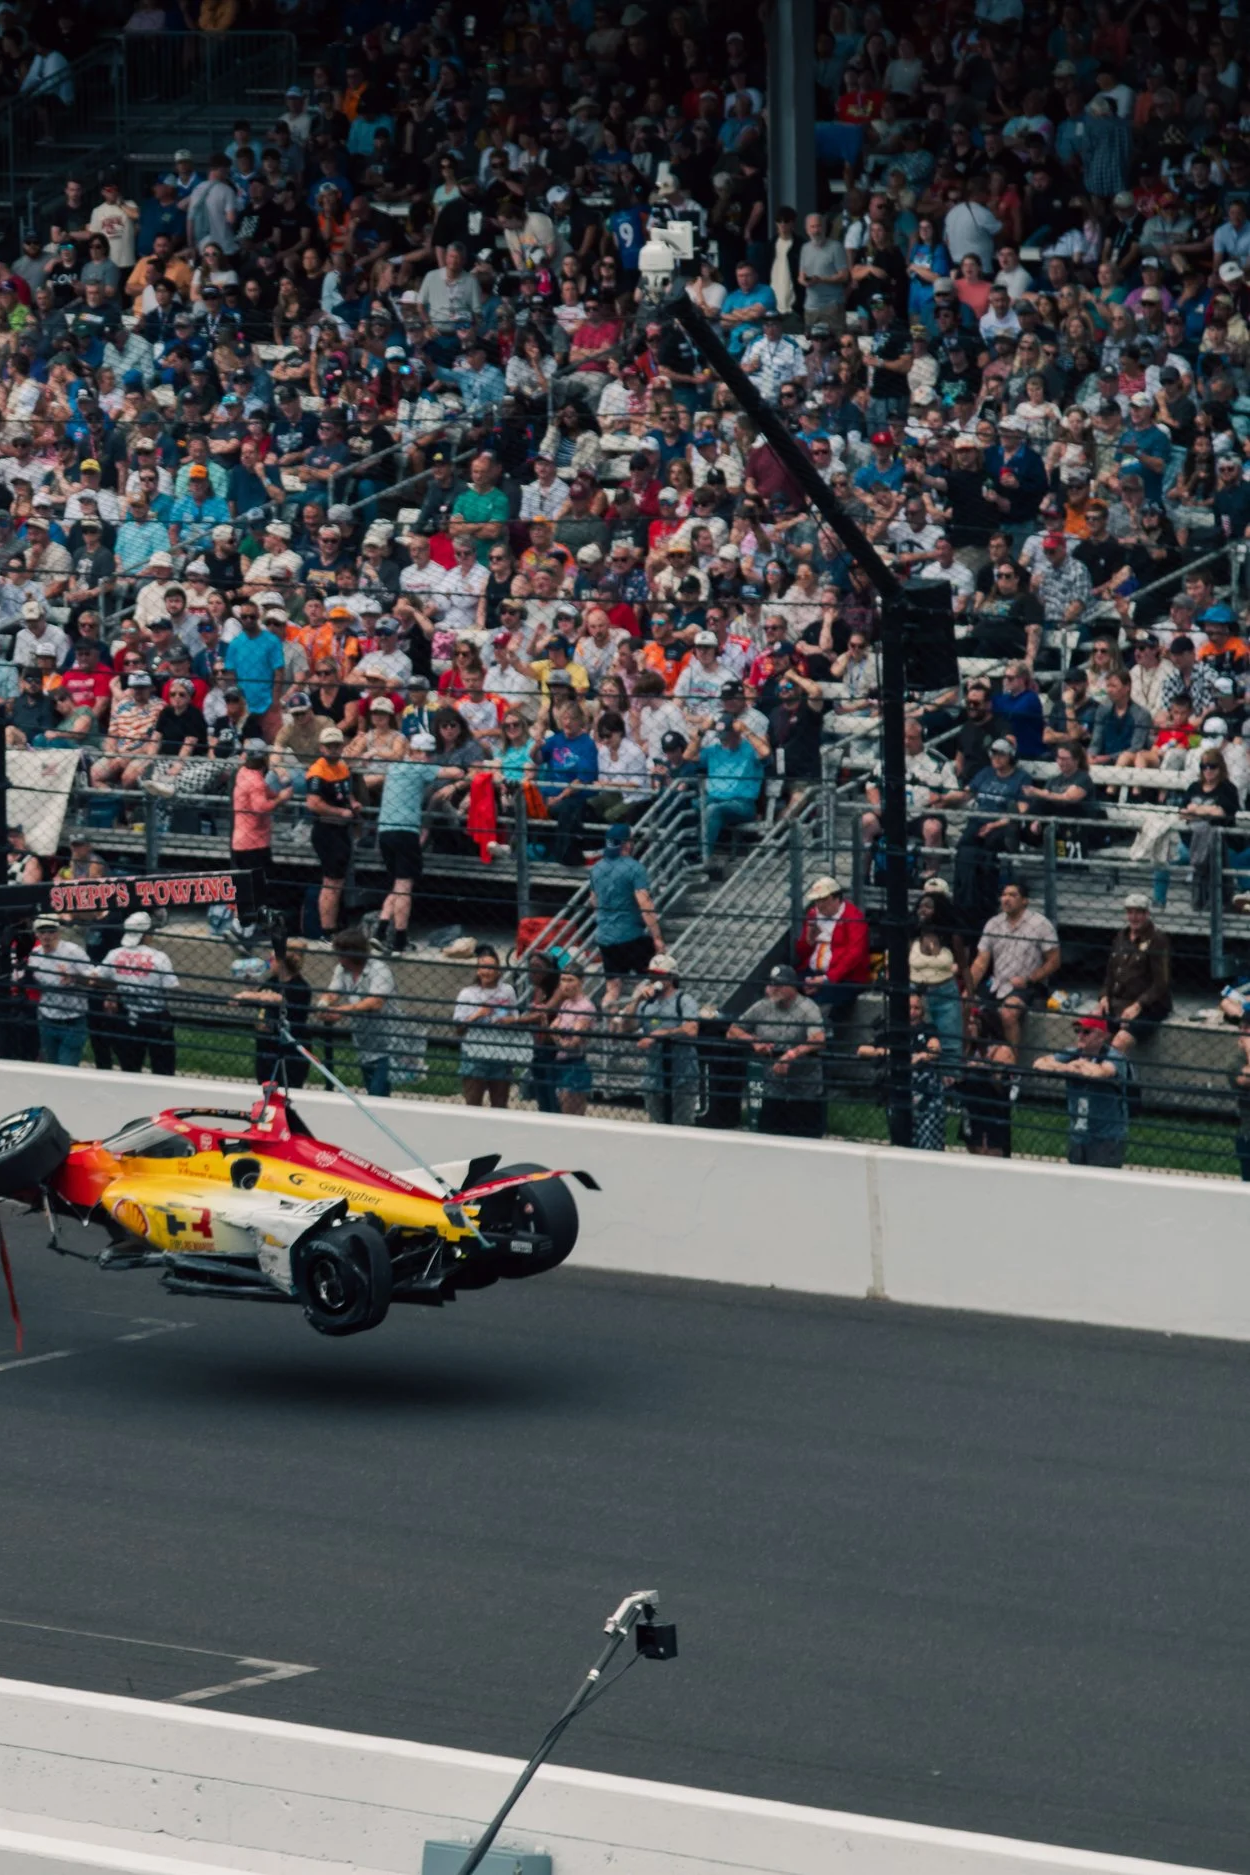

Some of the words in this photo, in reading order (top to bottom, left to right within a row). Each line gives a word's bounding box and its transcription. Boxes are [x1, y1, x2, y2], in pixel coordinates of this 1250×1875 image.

[619, 222, 634, 248] 9
[50, 883, 130, 912] STEPP'S
[135, 876, 237, 907] TOWING
[319, 1181, 383, 1206] Gallagher
